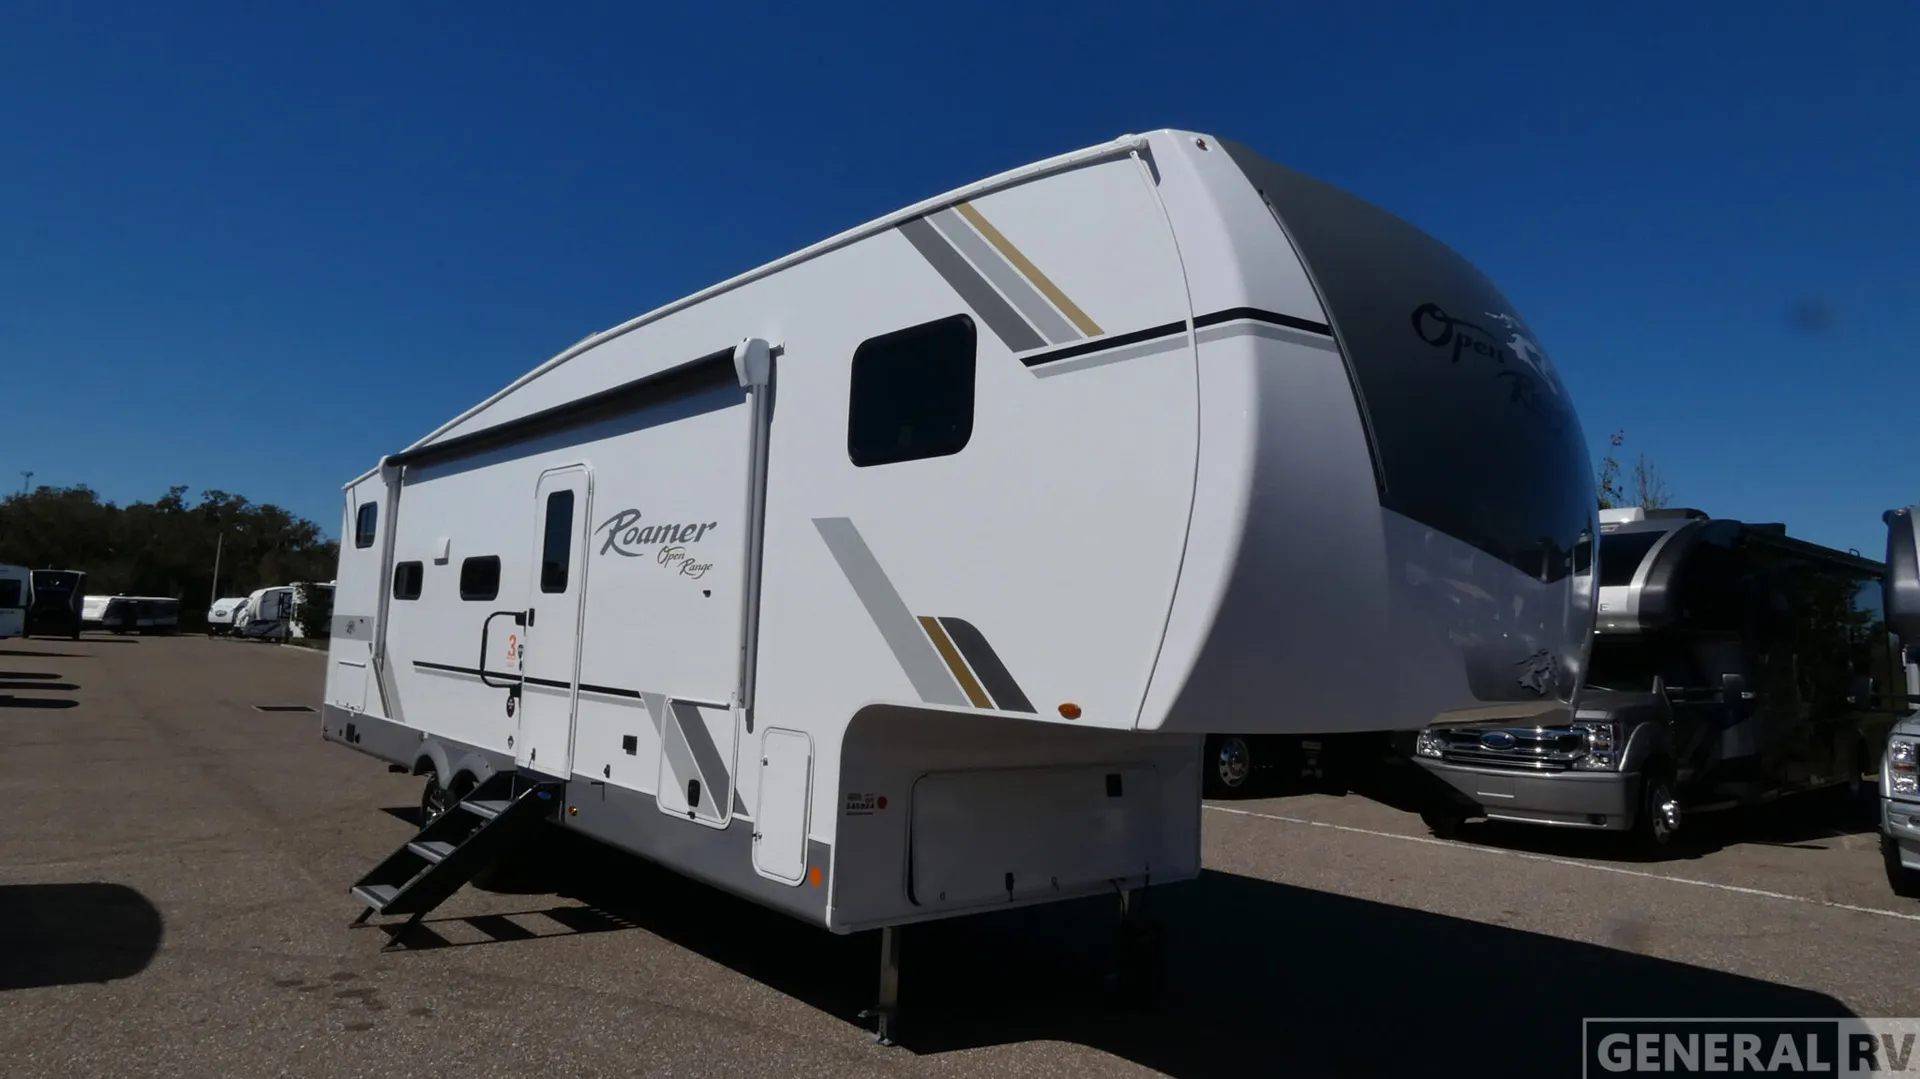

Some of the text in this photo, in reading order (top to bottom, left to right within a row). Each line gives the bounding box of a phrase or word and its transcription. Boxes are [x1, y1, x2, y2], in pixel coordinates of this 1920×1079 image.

[1411, 303, 1505, 363] Open
[594, 508, 718, 557] Roamer
[657, 546, 685, 568] Open
[676, 558, 713, 580] Range
